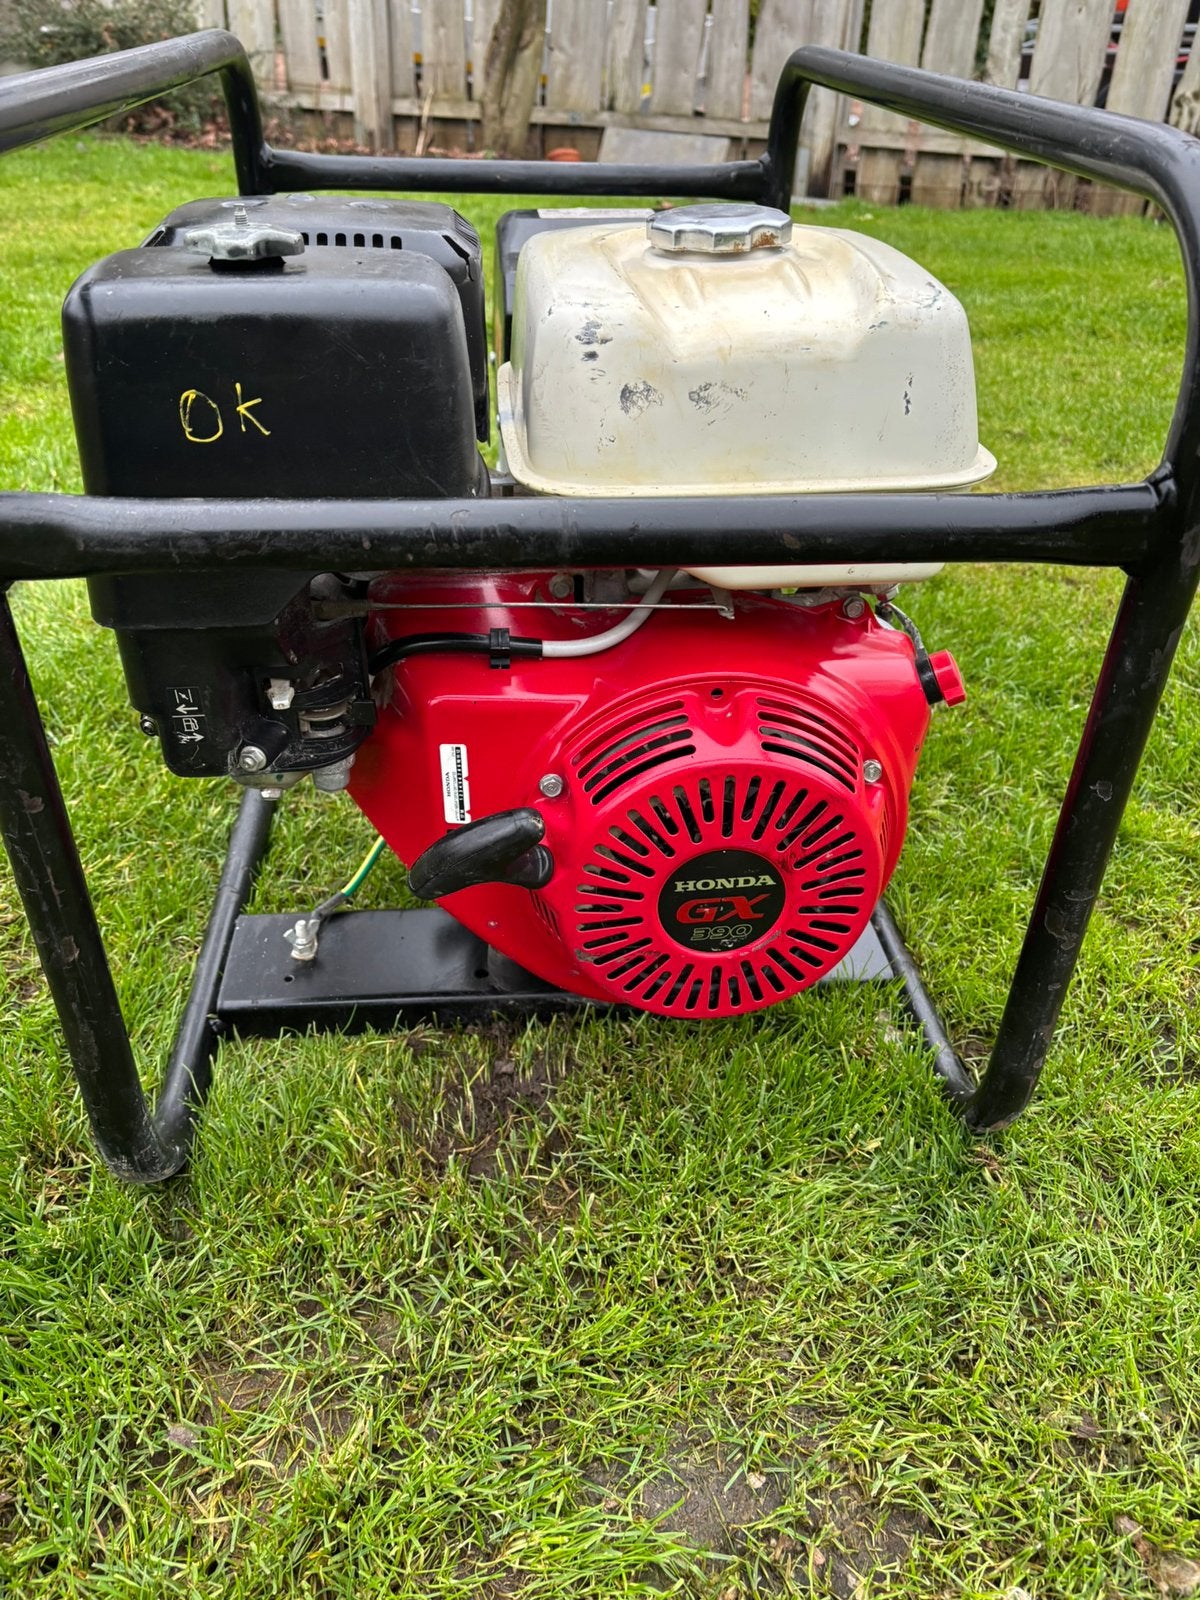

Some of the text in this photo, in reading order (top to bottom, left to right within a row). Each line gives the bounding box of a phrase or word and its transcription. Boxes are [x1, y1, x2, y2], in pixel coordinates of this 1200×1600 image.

[674, 875, 777, 893] HONDA
[676, 893, 772, 924] GX
[690, 924, 753, 941] 390
